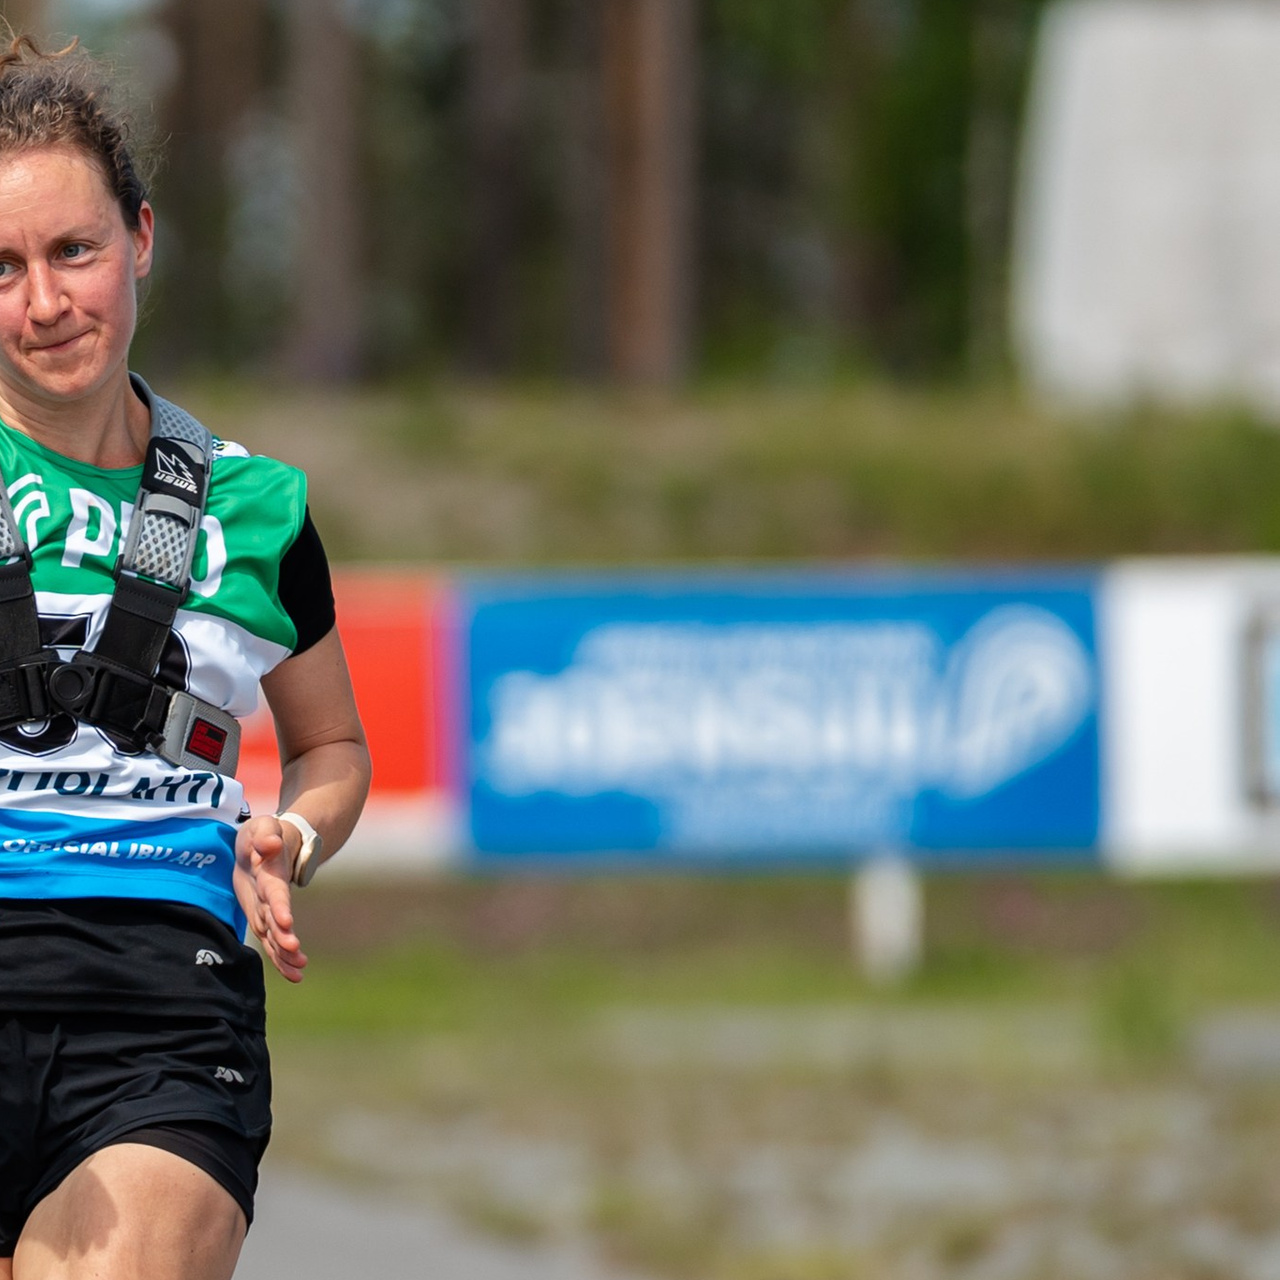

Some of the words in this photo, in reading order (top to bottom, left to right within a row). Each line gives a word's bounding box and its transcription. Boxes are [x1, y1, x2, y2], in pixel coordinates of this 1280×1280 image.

[3, 838, 120, 858] OFFICIAL
[127, 842, 173, 861] IBU
[169, 850, 217, 869] APP
